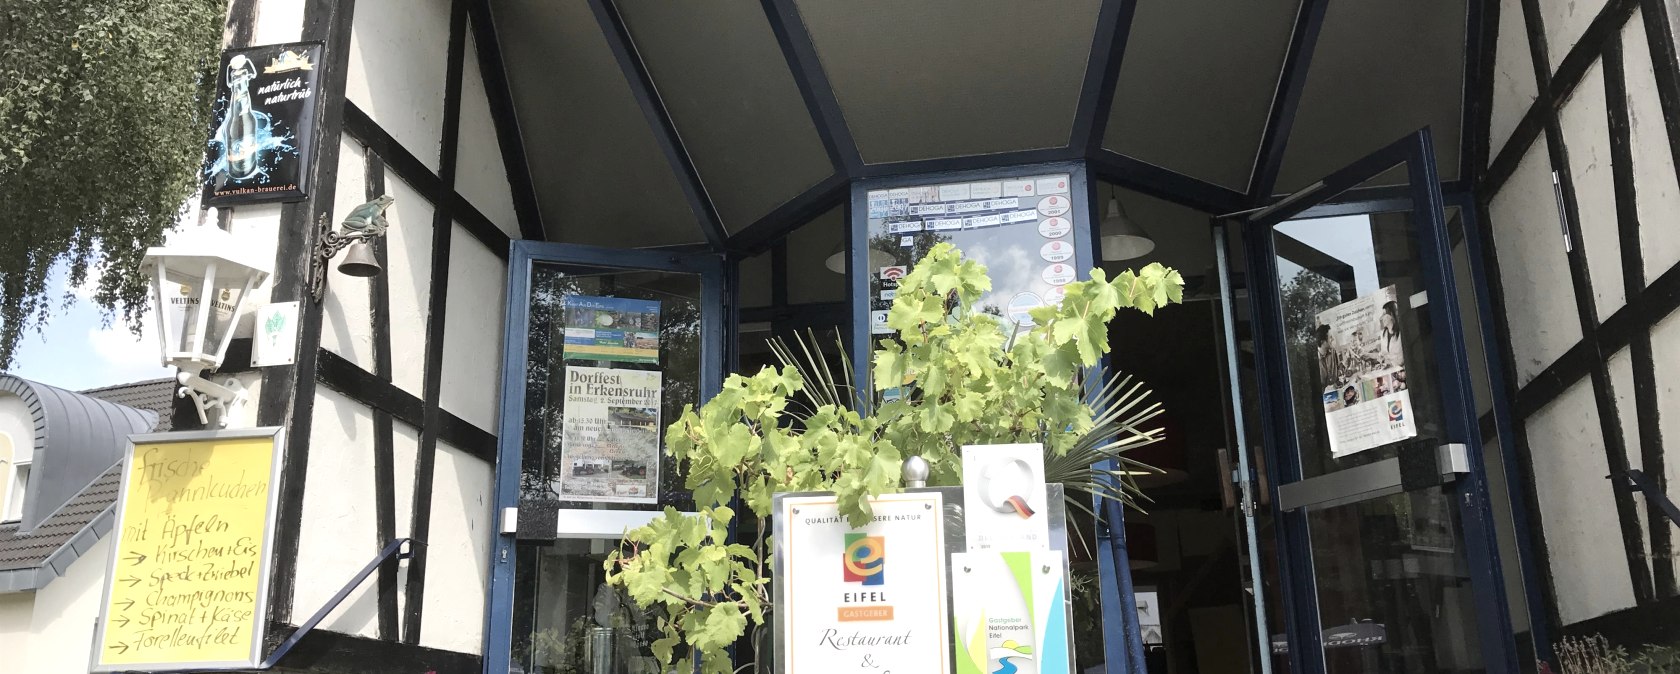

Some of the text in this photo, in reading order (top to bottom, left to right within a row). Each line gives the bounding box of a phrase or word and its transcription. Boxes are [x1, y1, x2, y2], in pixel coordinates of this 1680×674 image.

[257, 76, 301, 95] natürlich
[264, 88, 312, 106] naturtrüb
[213, 183, 297, 197] www.vulkan-brauerei.de
[918, 204, 944, 213] DEHOGA
[955, 202, 981, 211] DEHOGA
[989, 199, 1017, 208] DEHOGA
[973, 216, 998, 225] DEHOGA
[1009, 210, 1036, 220] DEHOGA
[935, 219, 960, 228] DEHOGA
[170, 297, 200, 305] VELTINS
[211, 299, 236, 313] VELTINS
[569, 370, 620, 385] Dorffest
[568, 382, 657, 399] in Erkensruhr
[568, 395, 598, 405] Samstag
[607, 397, 642, 408] September
[1390, 422, 1406, 431] EIFEL
[804, 515, 844, 526] QUALITÄT
[123, 514, 229, 549] mit Äpfeln
[146, 588, 254, 610] Champignons
[843, 591, 887, 603] EIFEL
[138, 607, 196, 628] Spinat
[212, 605, 252, 623] Käse
[842, 608, 889, 618] GASTGEBER
[988, 616, 1022, 625] Gastgeber
[988, 624, 1030, 632] Nationalpark
[819, 627, 913, 651] Restaurant
[860, 652, 881, 669] &
